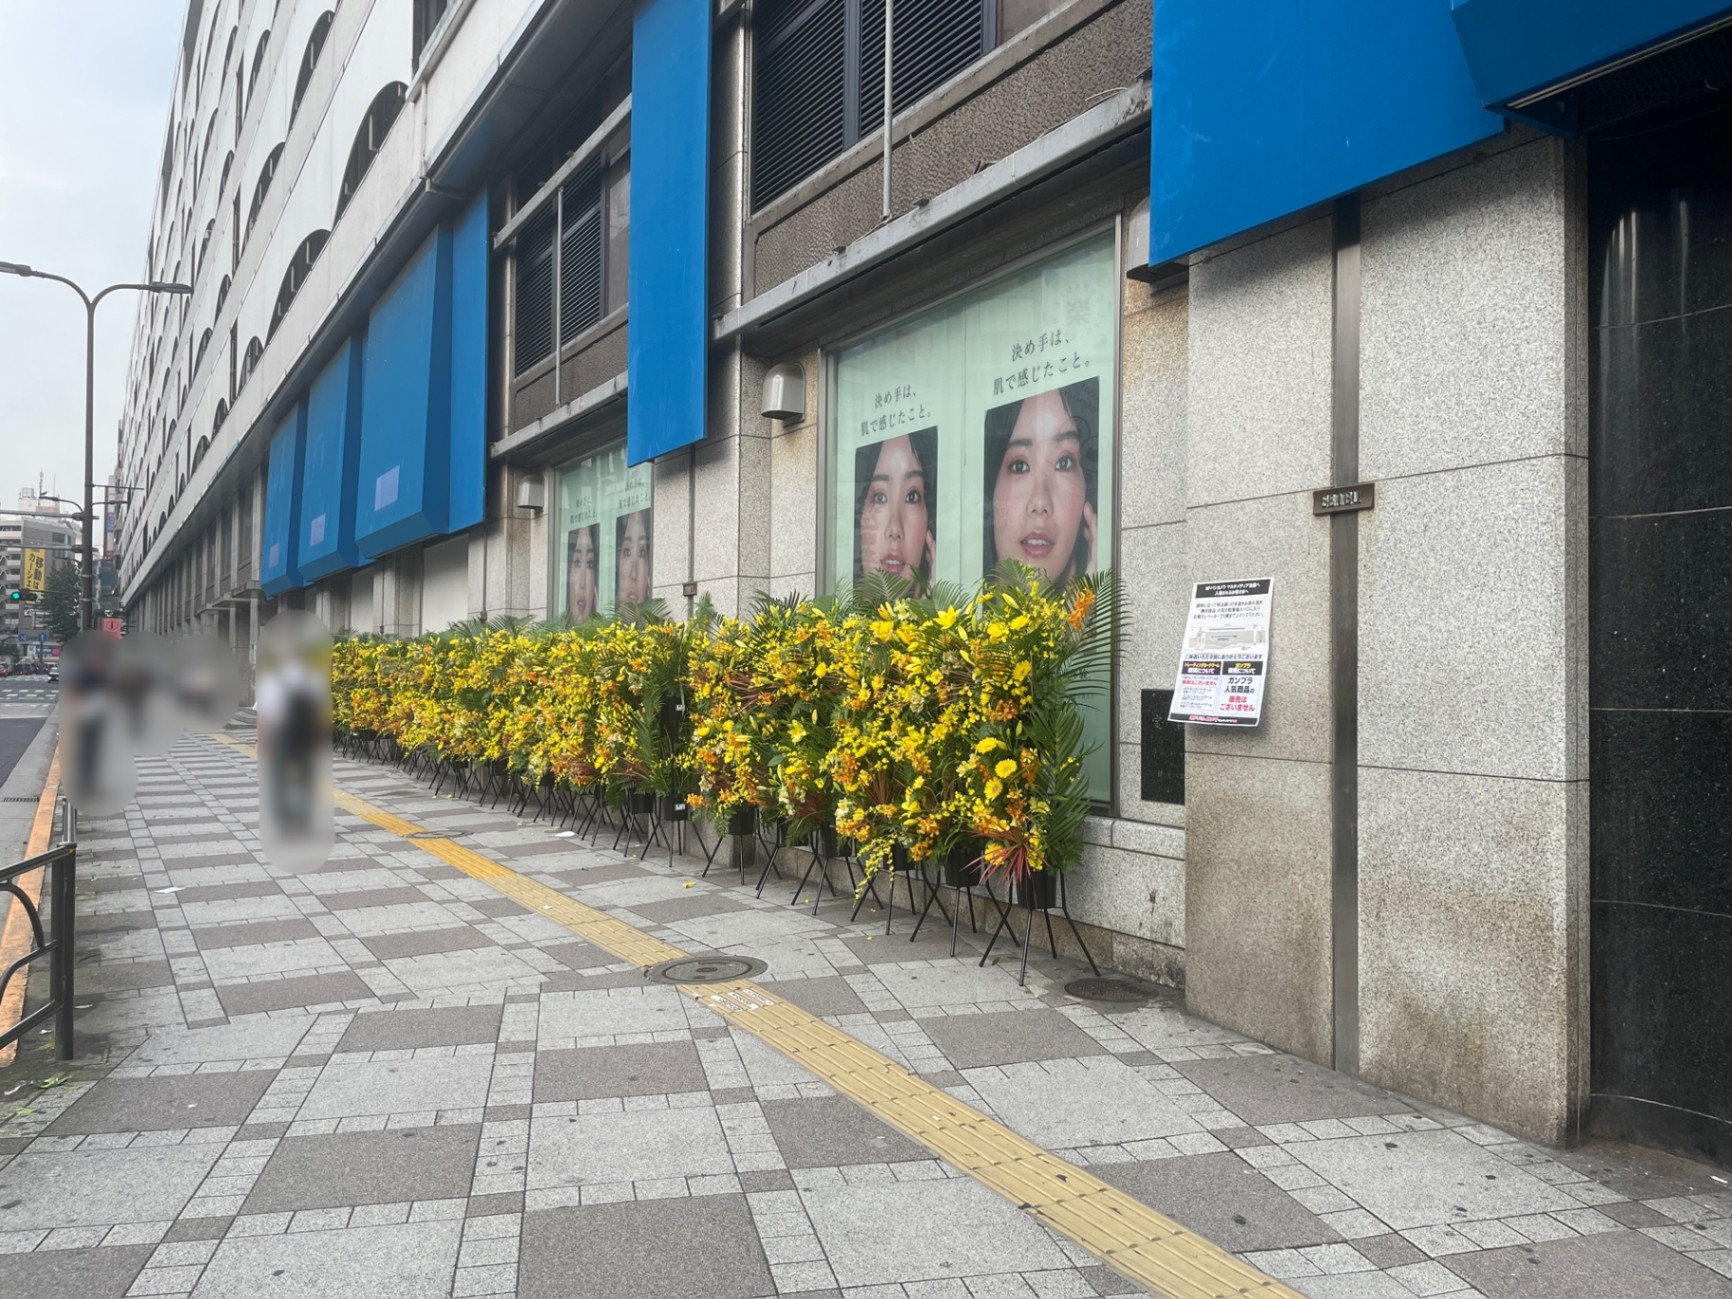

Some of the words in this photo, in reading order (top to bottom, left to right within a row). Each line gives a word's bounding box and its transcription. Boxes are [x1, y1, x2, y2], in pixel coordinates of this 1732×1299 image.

[1011, 329, 1070, 362] 決め手は、
[993, 351, 1091, 396] 肌で感じたこと。
[874, 383, 917, 409] 決め手は、
[860, 404, 932, 437] 肌で感じたこと。
[33, 556, 44, 589] 移動は
[1224, 686, 1255, 694] 人気商品の
[1219, 703, 1255, 712] ございません
